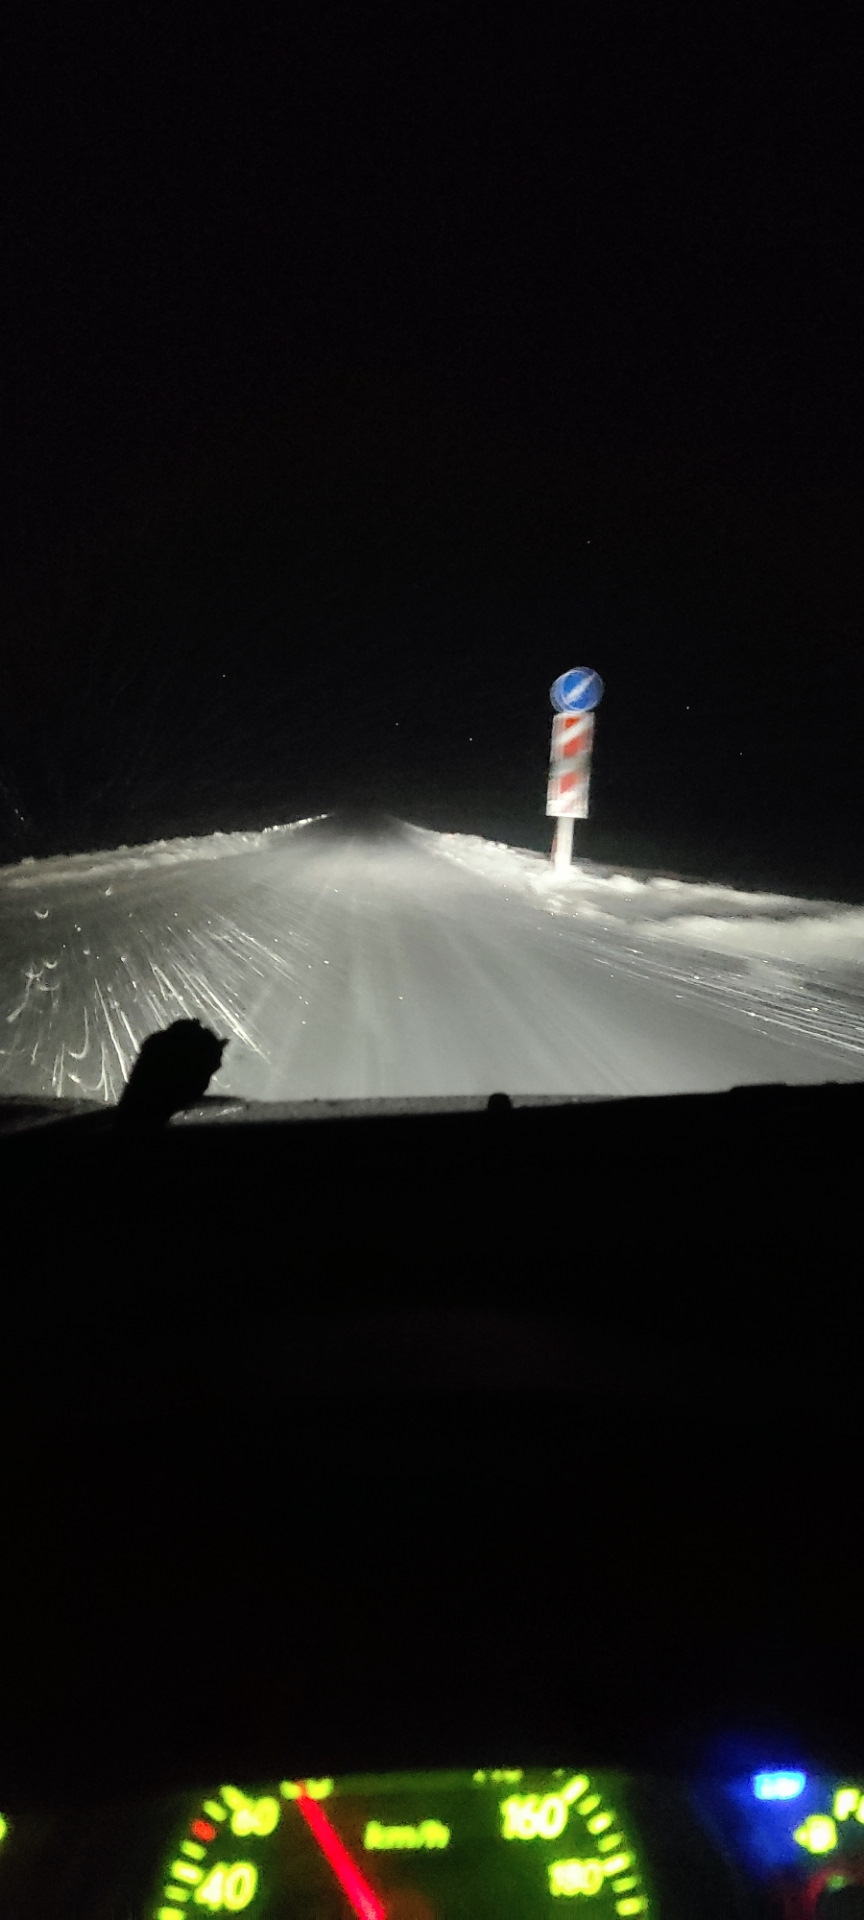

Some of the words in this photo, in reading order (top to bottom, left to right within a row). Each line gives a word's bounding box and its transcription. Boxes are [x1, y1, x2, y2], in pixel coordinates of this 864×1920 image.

[364, 1820, 449, 1849] km/h
[501, 1794, 568, 1839] 160
[195, 1862, 256, 1910] 40
[548, 1858, 603, 1895] 180
